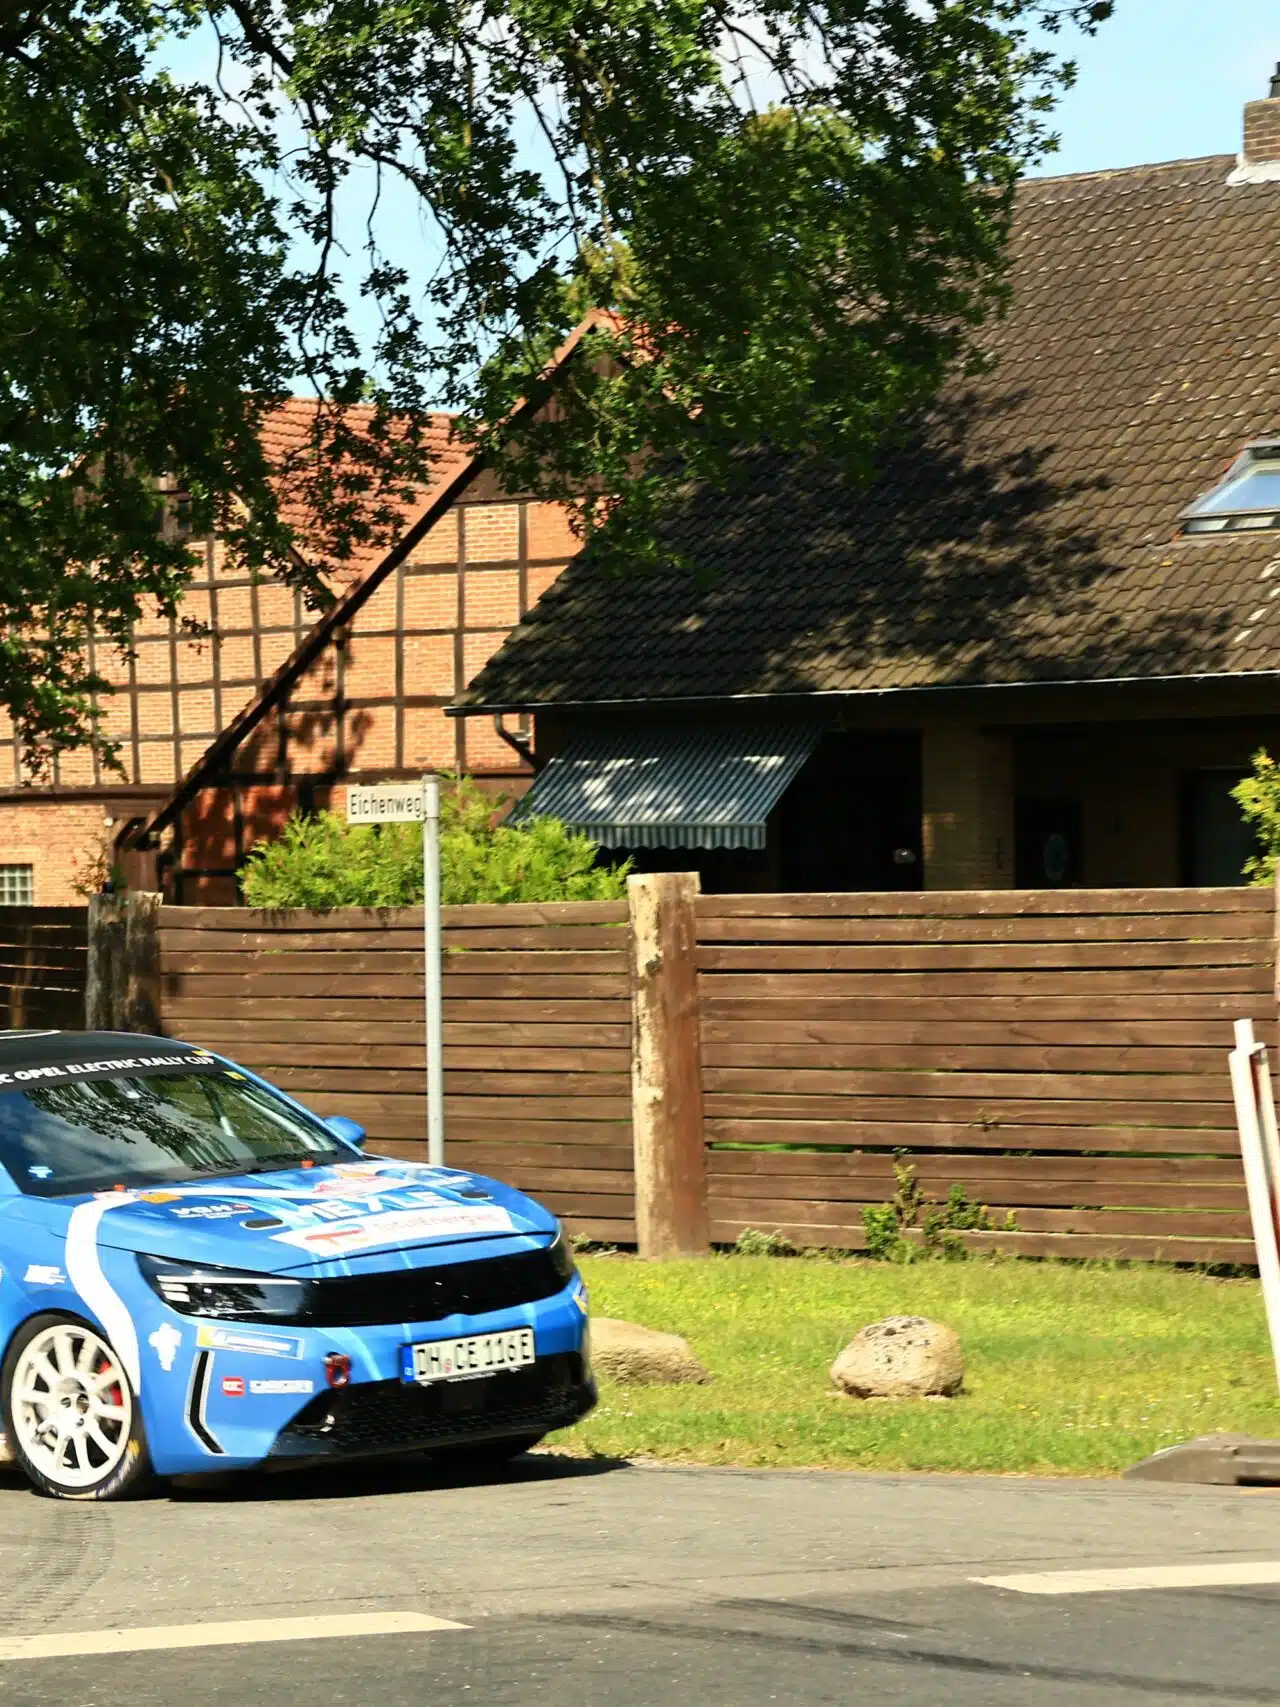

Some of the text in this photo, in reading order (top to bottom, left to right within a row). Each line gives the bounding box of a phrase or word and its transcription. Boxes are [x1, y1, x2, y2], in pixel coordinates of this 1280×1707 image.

[350, 793, 422, 818] Eichenweg
[14, 1066, 67, 1082] OPEL
[65, 1058, 143, 1075] ELECTRIC
[140, 1055, 187, 1067] RALLY
[183, 1055, 215, 1065] CUP
[281, 1190, 464, 1229] MEYLE
[417, 1346, 442, 1376] DH
[455, 1340, 478, 1370] CE
